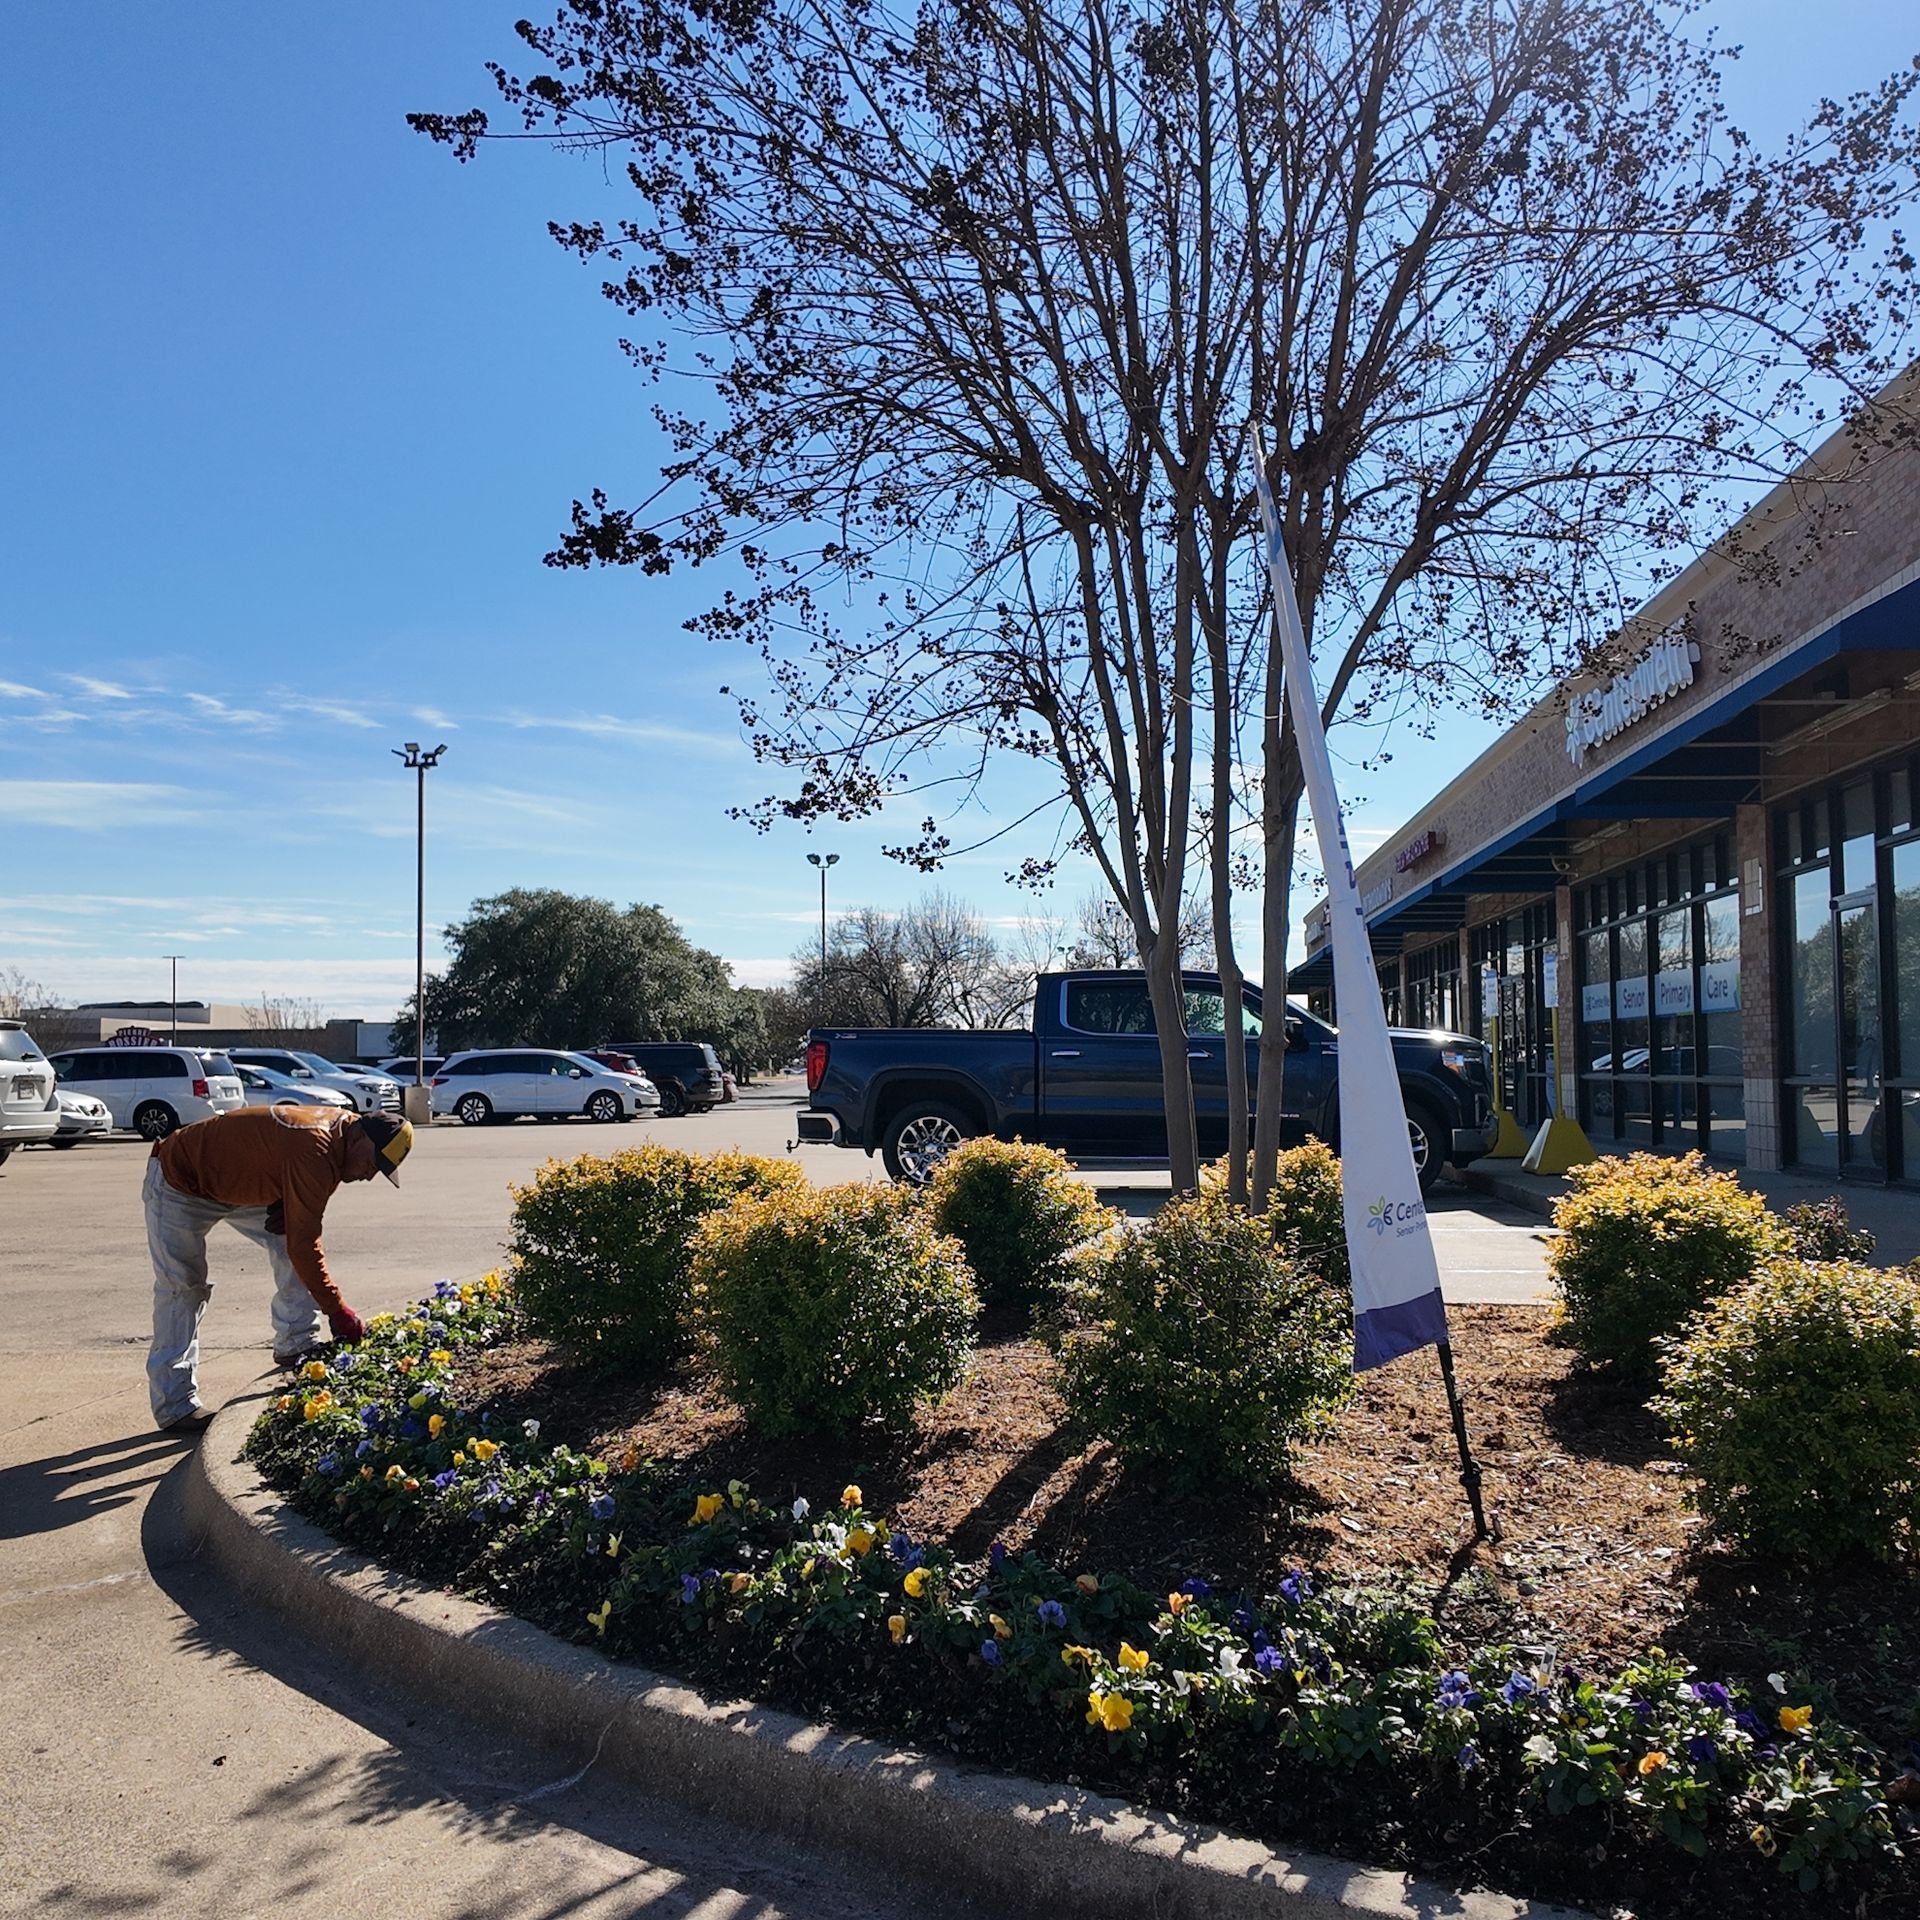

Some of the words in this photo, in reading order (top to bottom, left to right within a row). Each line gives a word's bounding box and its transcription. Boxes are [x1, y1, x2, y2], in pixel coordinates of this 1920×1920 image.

[1623, 987, 1645, 1009] Senior
[1660, 982, 1692, 1008] Primary
[1706, 974, 1728, 999] Care
